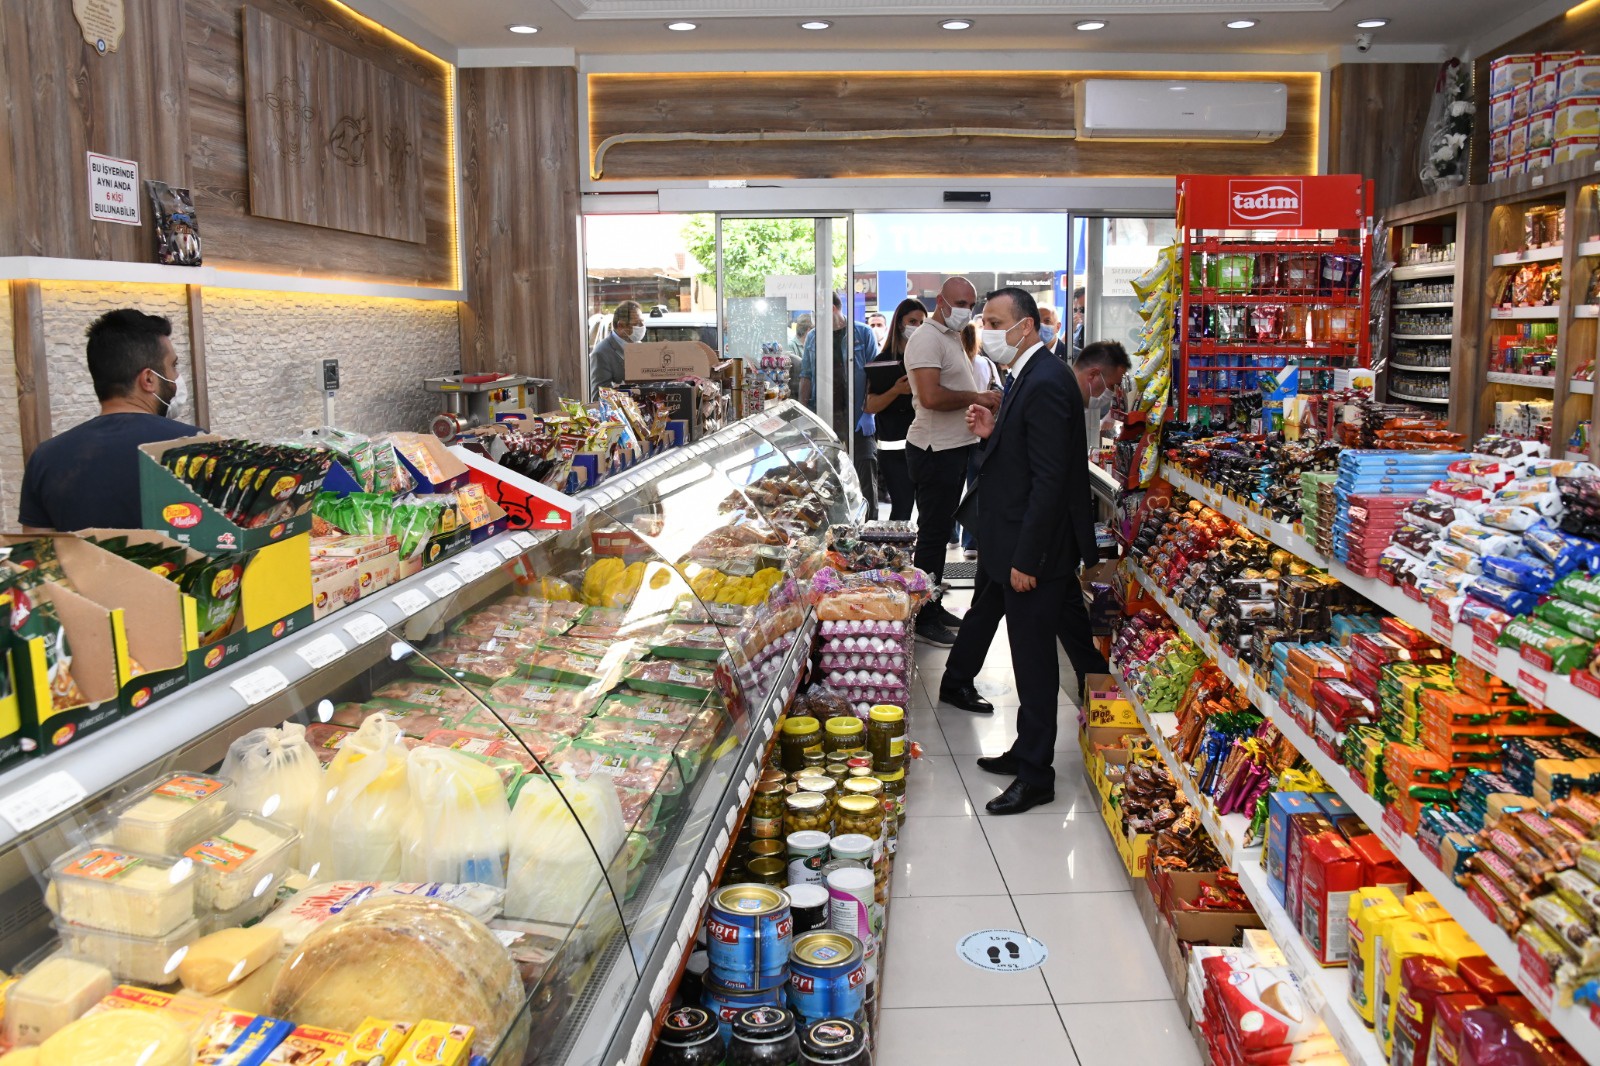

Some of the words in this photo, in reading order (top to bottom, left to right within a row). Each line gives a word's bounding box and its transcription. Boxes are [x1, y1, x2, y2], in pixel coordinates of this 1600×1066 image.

[92, 163, 101, 172] BU
[102, 165, 135, 180] İŞYERİNDE
[97, 177, 113, 187] AYNI
[113, 180, 131, 192] ANDA
[106, 191, 111, 200] 6
[111, 192, 124, 203] KİŞİ
[1232, 194, 1299, 210] tadım
[94, 203, 136, 218] BULUNABİLİR
